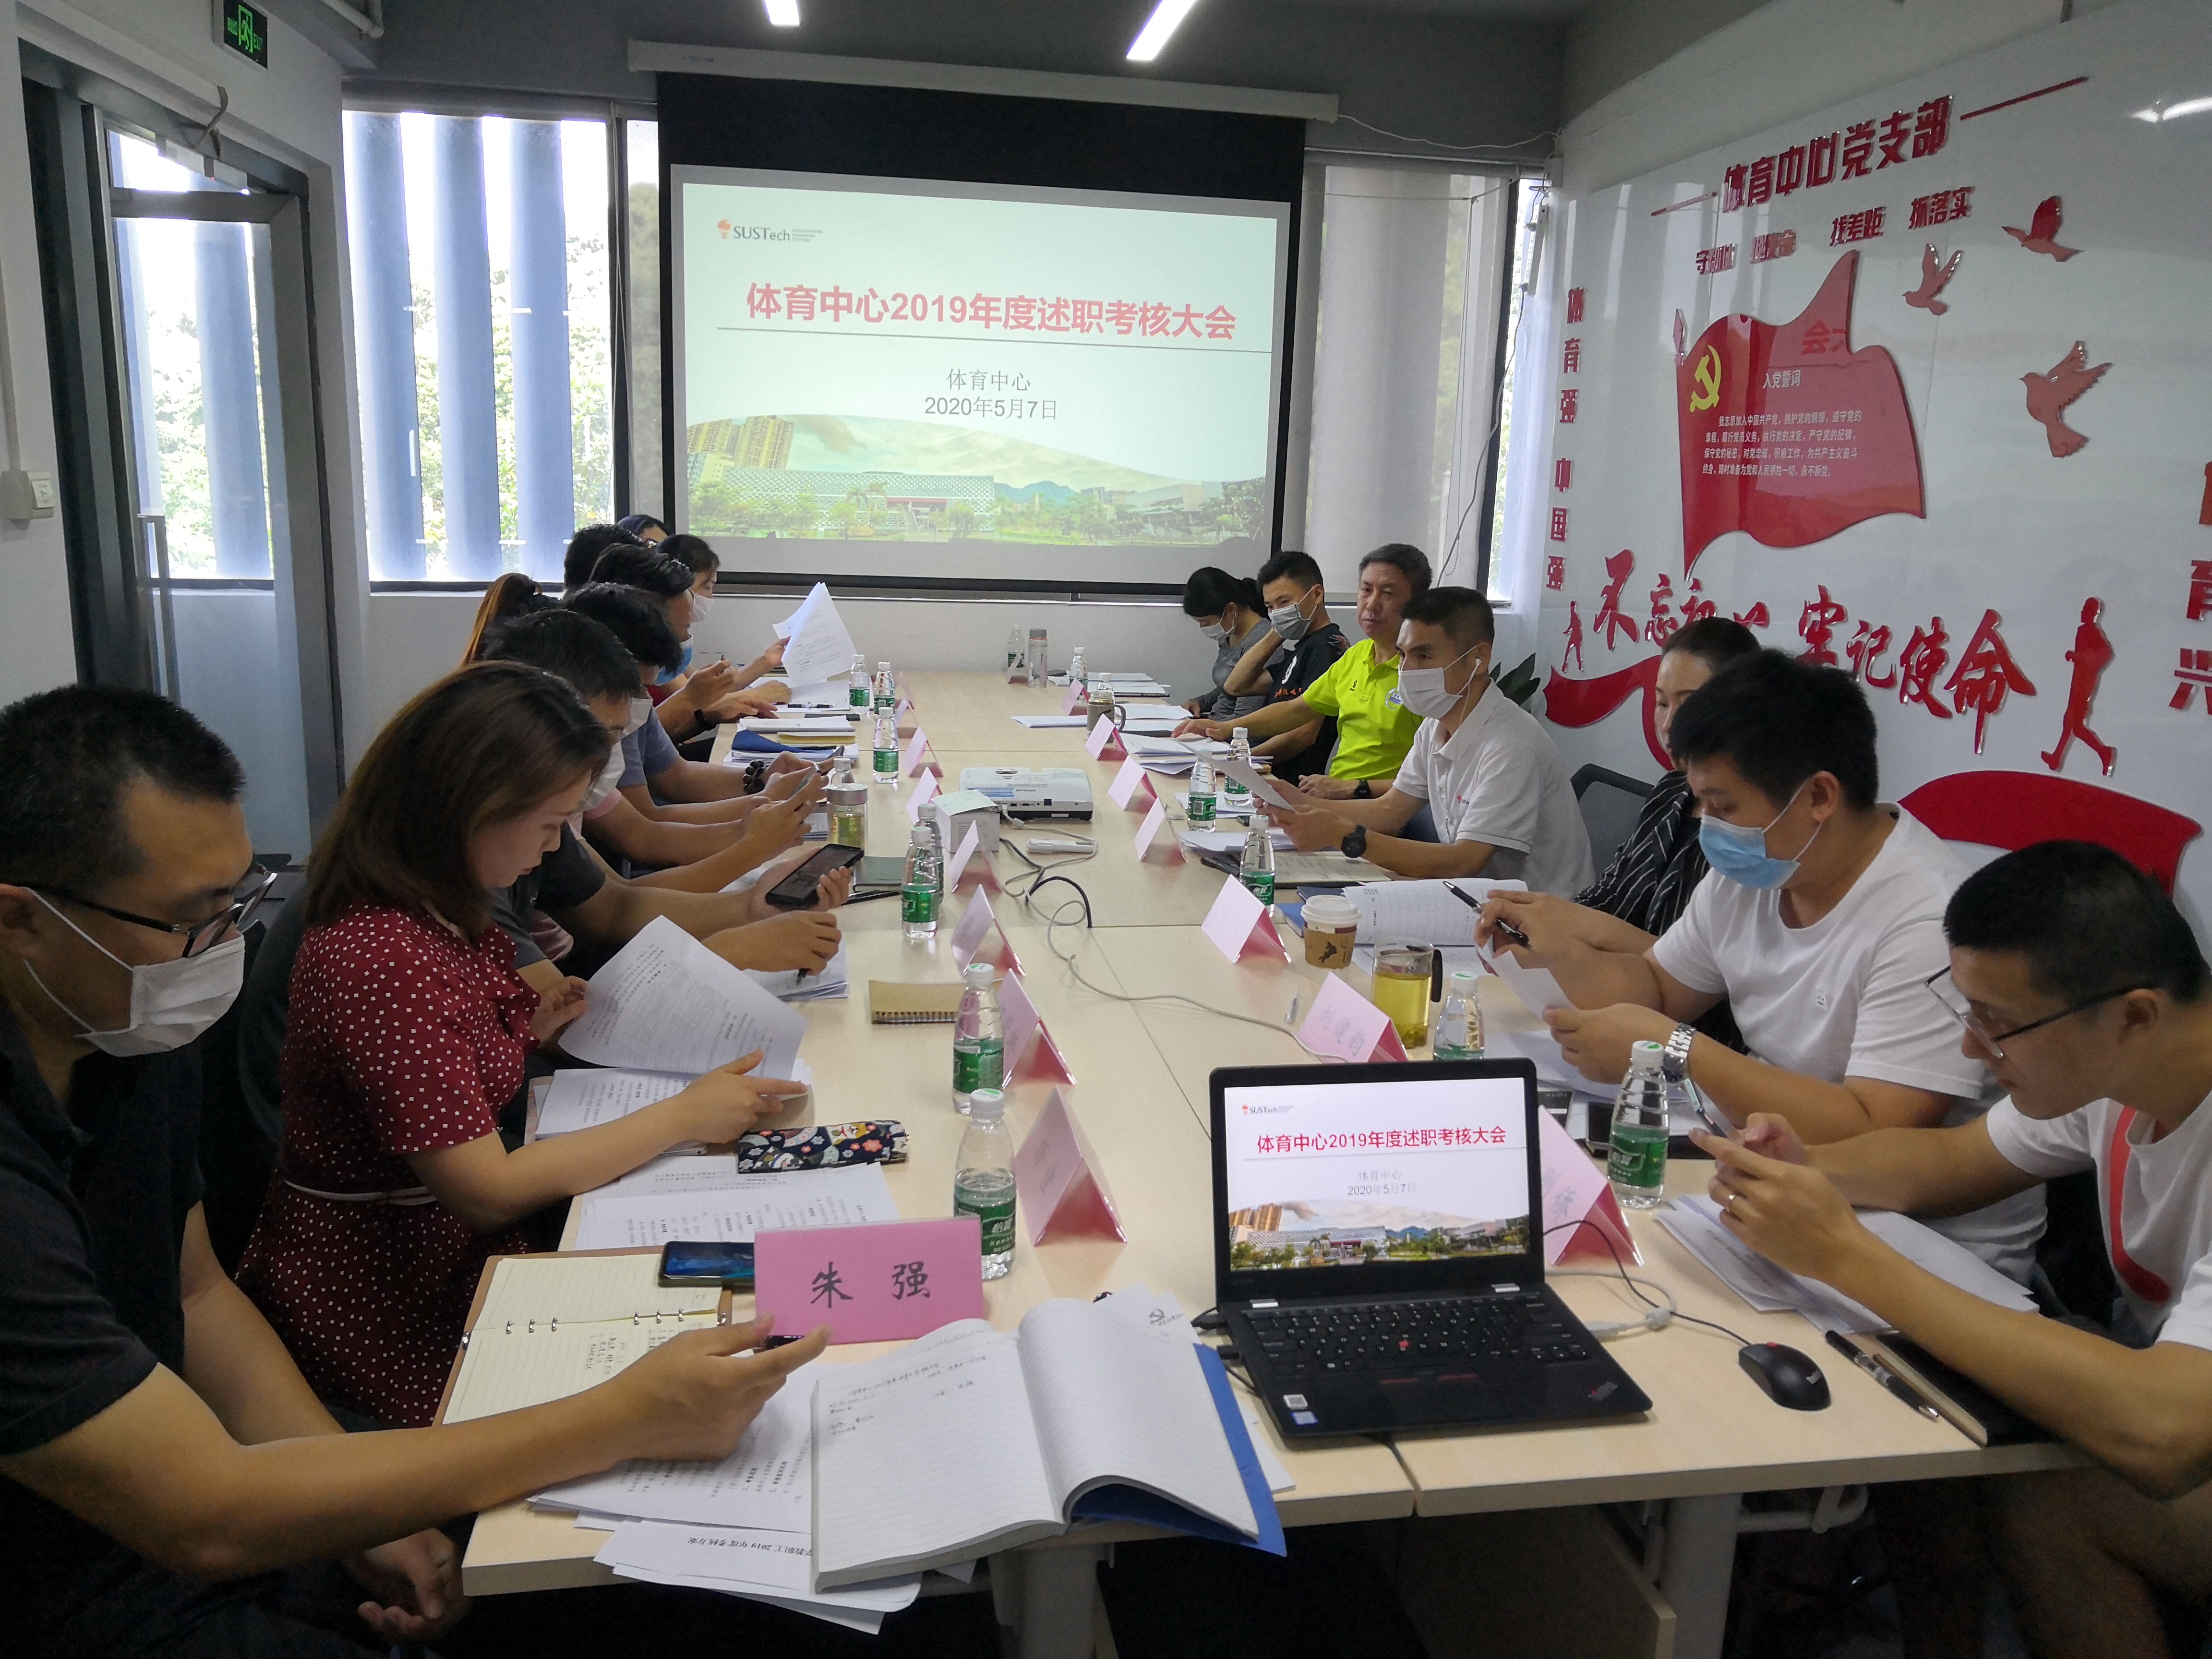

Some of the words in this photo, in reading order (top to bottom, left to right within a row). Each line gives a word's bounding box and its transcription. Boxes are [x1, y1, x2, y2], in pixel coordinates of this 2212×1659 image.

[1722, 95, 1954, 213] 体育中心党支部
[1830, 206, 1887, 247] 找差距
[1908, 186, 1976, 229] 抓落实
[733, 226, 791, 241] SUSTech
[746, 282, 1236, 340] 体育中心2019年度述职考核大会
[947, 369, 1031, 392] 体育中心
[1763, 369, 1802, 389] 入党誓词
[925, 397, 1057, 420] 2020年5月7日
[1795, 584, 2037, 755] 牢记使命
[1257, 1125, 1506, 1154] 体育中心2019年度述职考核大会
[1358, 1169, 1402, 1181] 体育中心
[1347, 1182, 1417, 1196] 2020年5月7日
